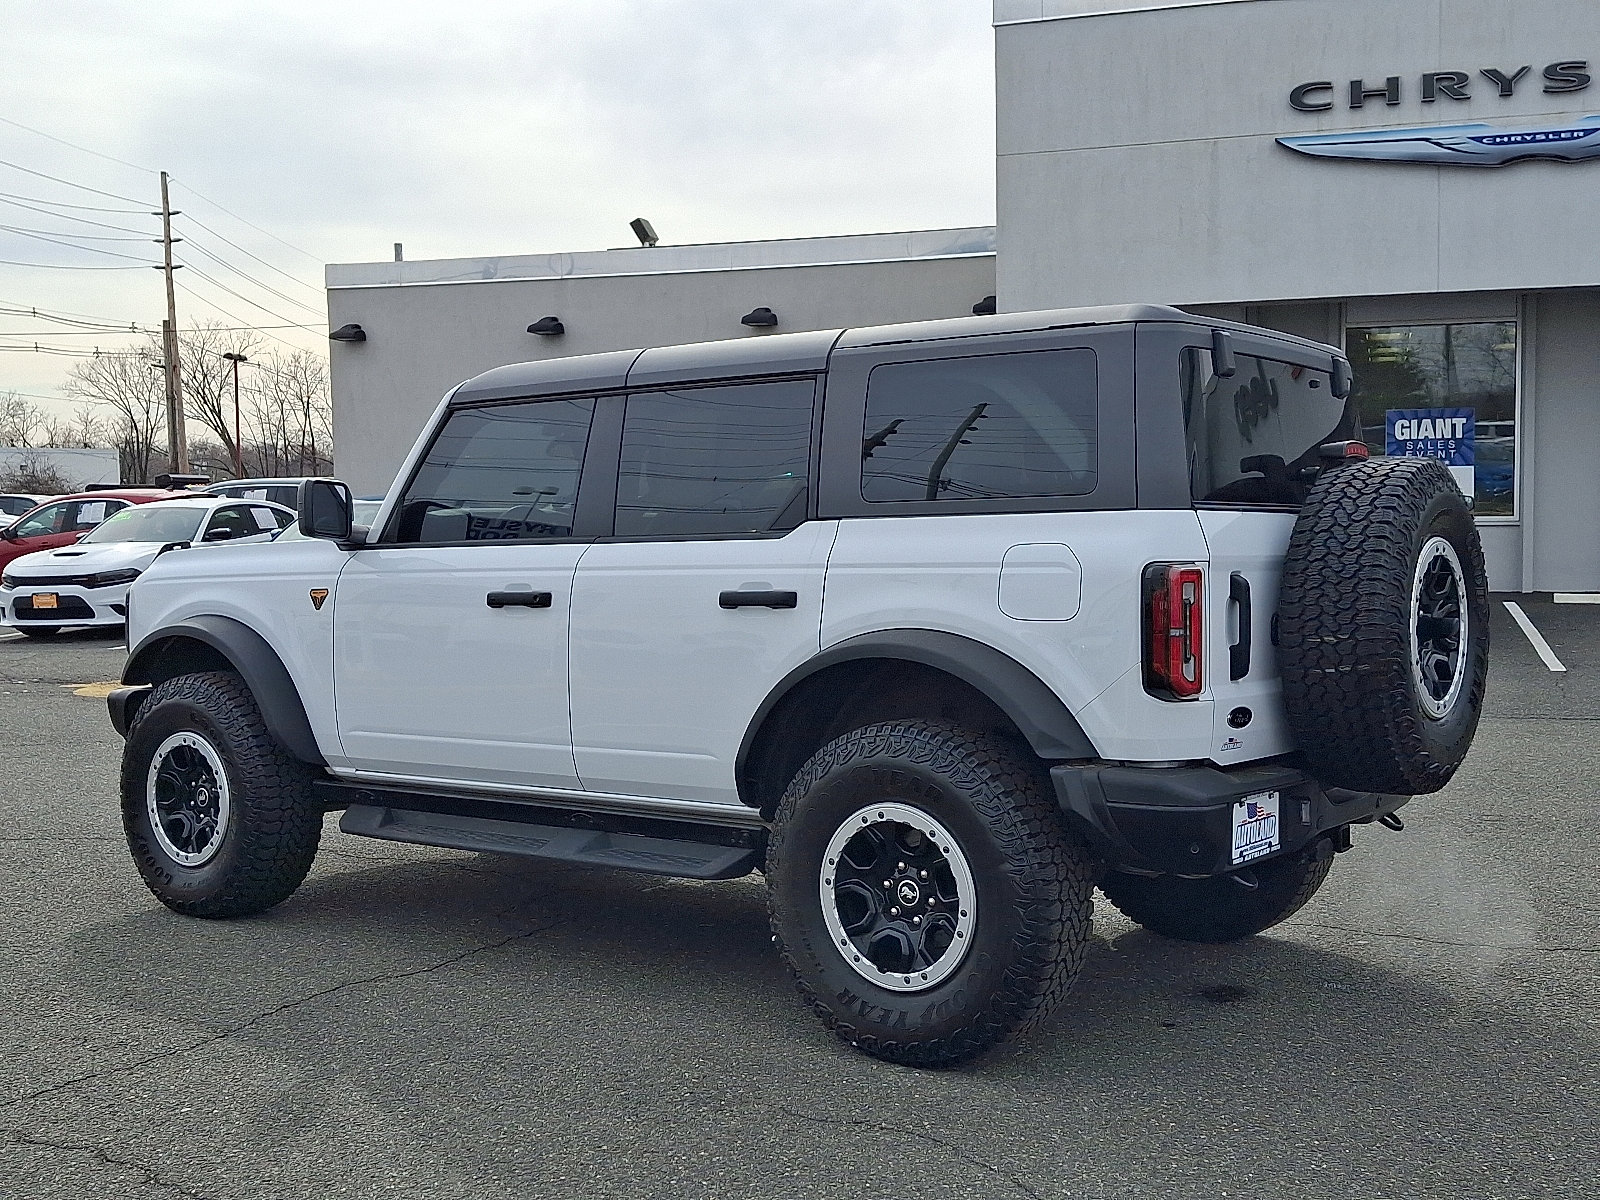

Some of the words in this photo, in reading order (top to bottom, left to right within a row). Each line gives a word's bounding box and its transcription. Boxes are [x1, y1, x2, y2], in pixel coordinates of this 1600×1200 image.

[1288, 60, 1592, 111] CHRYS
[1481, 130, 1586, 145] CHRYSLER
[1394, 417, 1467, 441] GIANT
[1405, 439, 1456, 450] SALES
[1235, 816, 1277, 849] AUTOLAND
